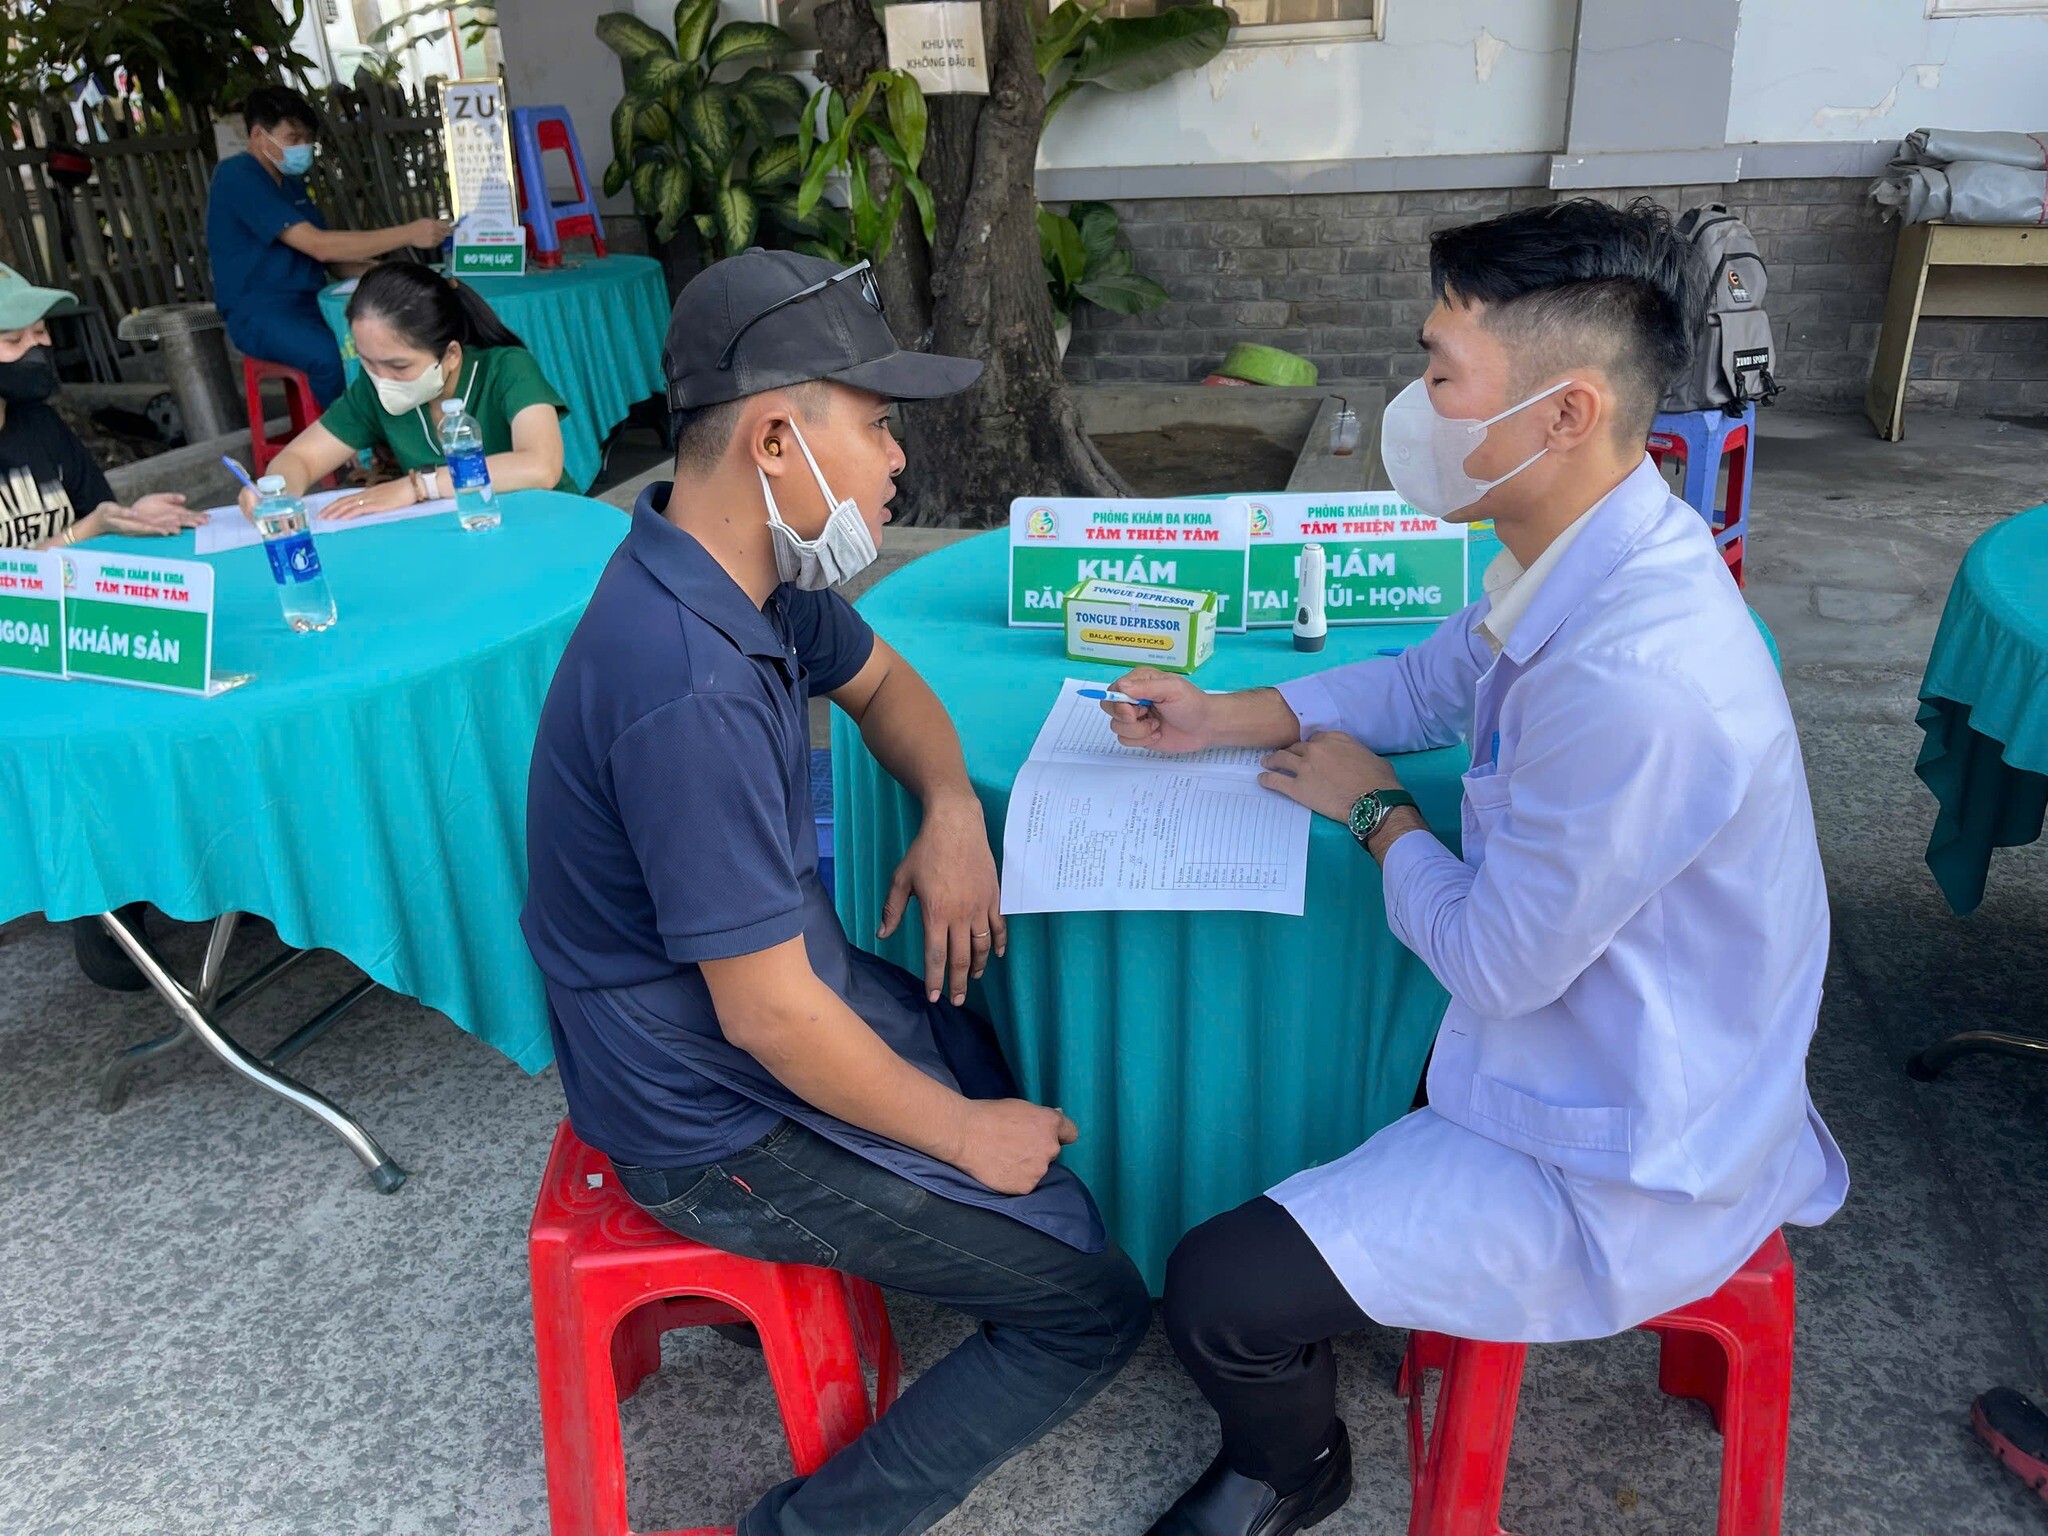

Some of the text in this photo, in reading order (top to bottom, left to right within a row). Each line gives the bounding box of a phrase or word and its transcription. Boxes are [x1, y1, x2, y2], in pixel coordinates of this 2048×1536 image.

[921, 39, 944, 50] KHU
[906, 56, 945, 69] KHÔNG
[1093, 509, 1212, 524] PHÒNG KHÁM ĐA KHOA
[1308, 504, 1344, 518] PHÒNG
[1348, 503, 1380, 517] KHÁM
[1383, 504, 1398, 516] ĐA
[1086, 527, 1219, 543] TÂM THIỆN TÂM
[1301, 518, 1437, 536] TÂM THIỆN TÂM
[127, 567, 149, 581] KHÁM
[164, 573, 185, 585] KHOA
[1078, 554, 1177, 584] KHÁM
[20, 576, 43, 591] TÂM
[95, 580, 189, 602] TÂM THIỆN TÂM
[1093, 586, 1134, 598] TONGUE
[1136, 592, 1195, 606] DEPRESSOR
[1249, 589, 1288, 609] TAI
[1324, 583, 1352, 607] ŨI
[1369, 585, 1442, 611] HỌNG
[1075, 611, 1181, 631] TONGUE DEPRESSOR
[0, 619, 49, 654] GOẠI
[68, 625, 180, 664] KHÁM SẢN
[1089, 632, 1164, 646] BALAC WOOD STICKS
